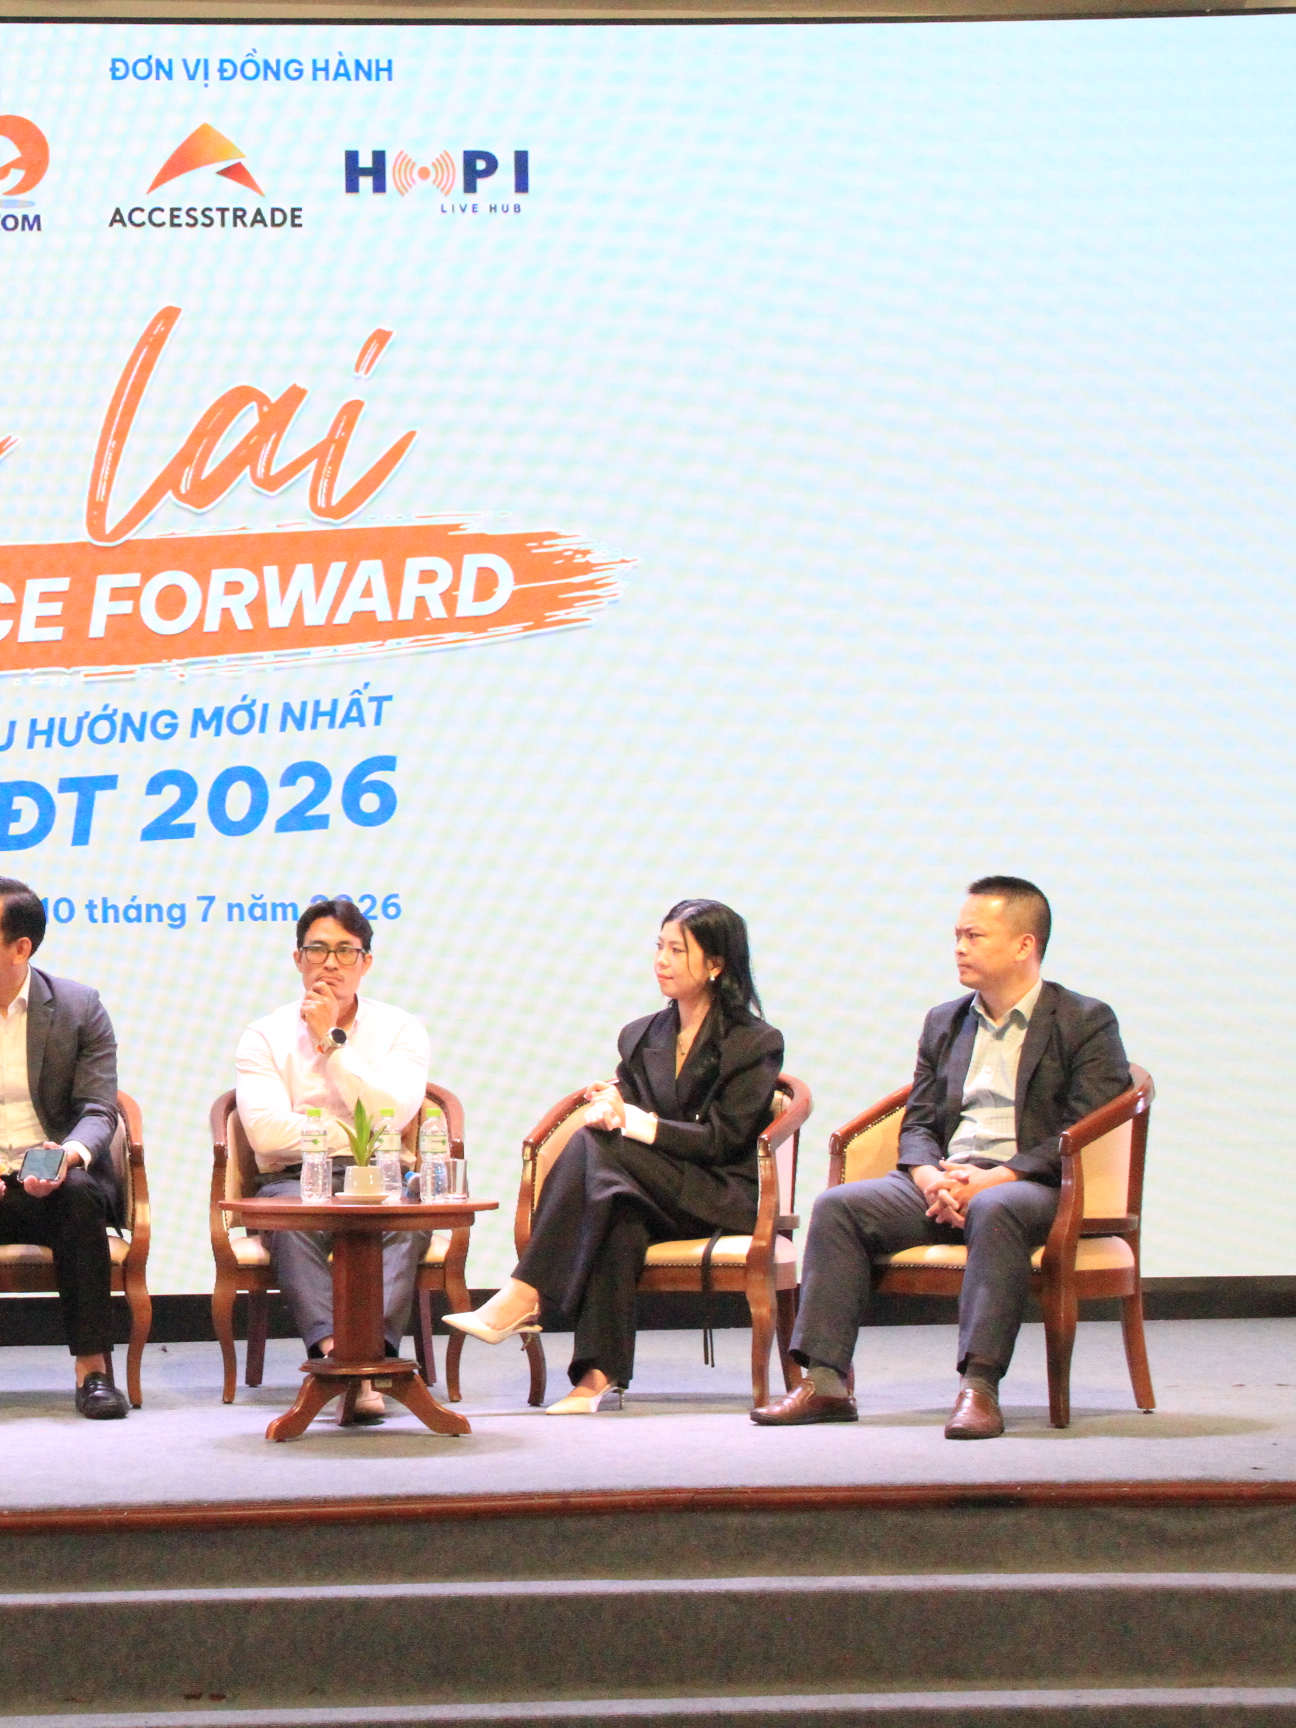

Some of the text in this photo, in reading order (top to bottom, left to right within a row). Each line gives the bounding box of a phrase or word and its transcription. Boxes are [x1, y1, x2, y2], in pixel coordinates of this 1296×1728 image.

[108, 47, 394, 88] ĐƠN VỊ ĐỒNG HÀNH
[108, 206, 303, 228] ACCESSTRADE
[440, 203, 522, 214] LIVE HUB
[87, 552, 515, 640] FORWARD
[26, 703, 180, 750] HƯỚNG
[189, 693, 270, 739] MỚI
[279, 681, 395, 733] NHẤT
[139, 754, 399, 842] 2026
[84, 895, 187, 930] tháng
[196, 895, 217, 923] 7
[226, 893, 300, 922] năm
[310, 893, 403, 921] 26
